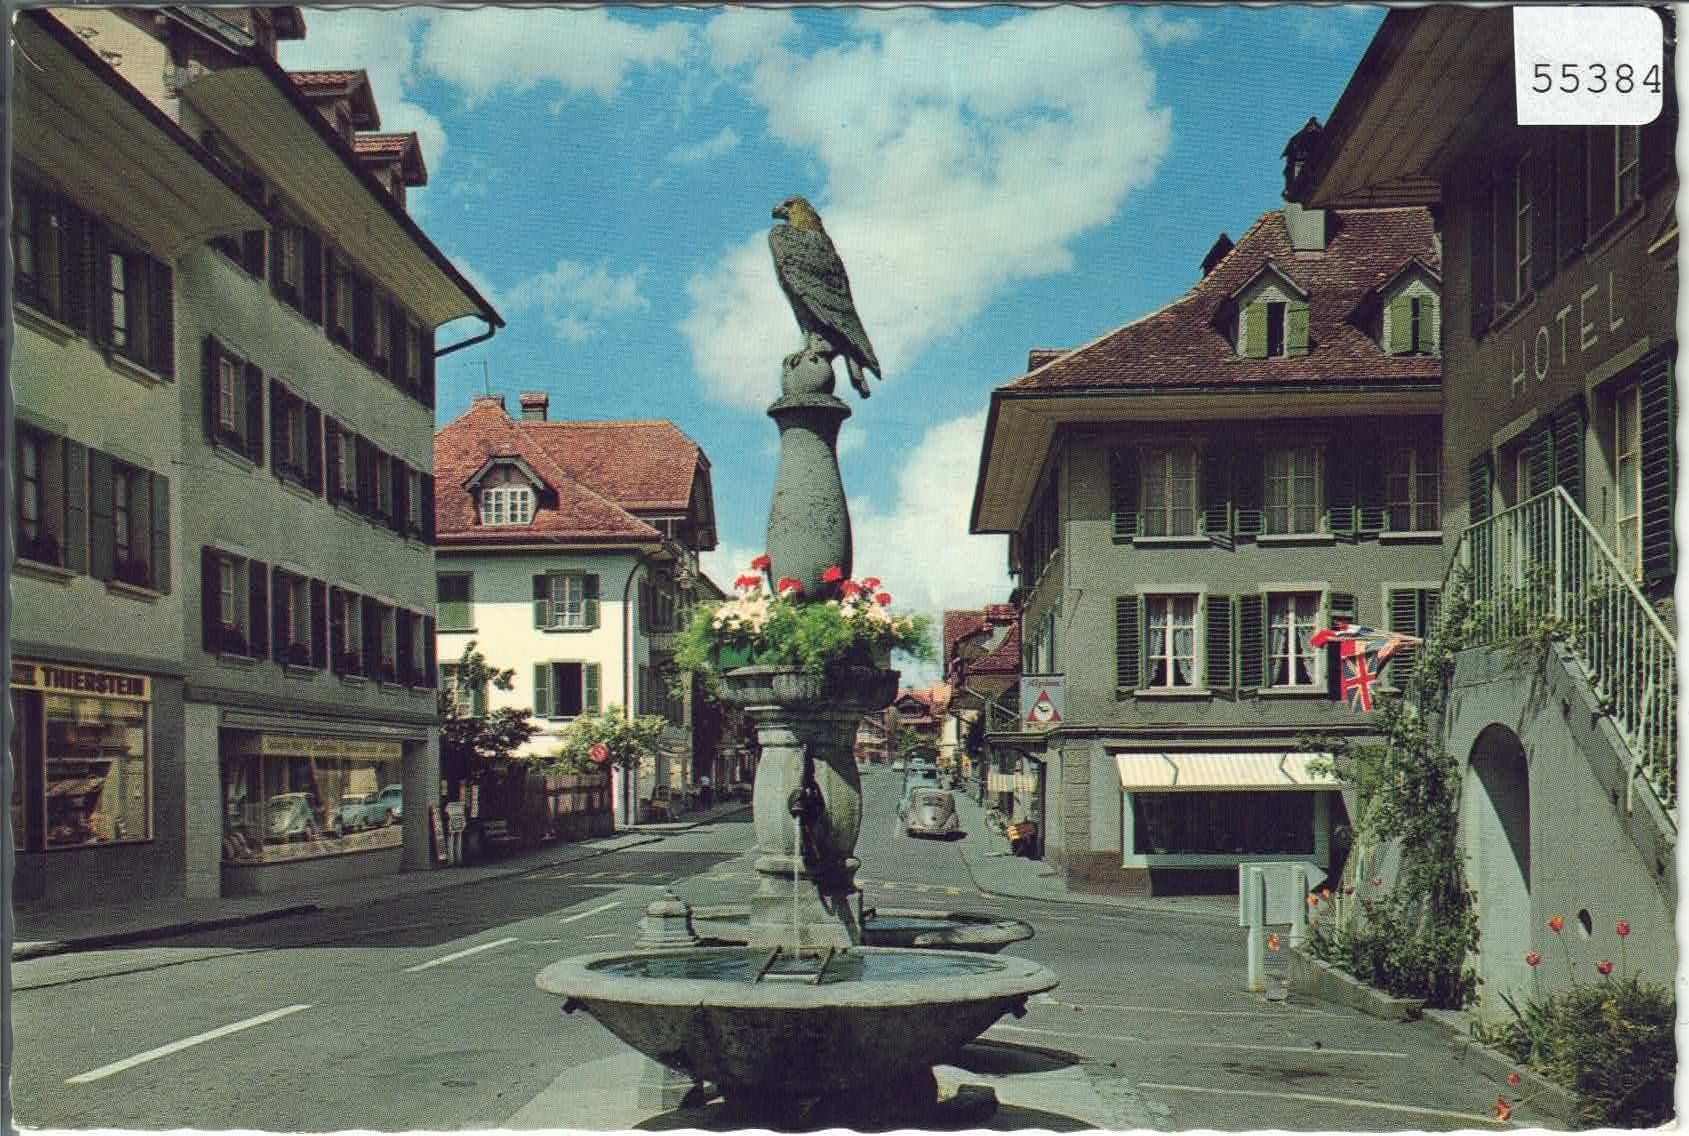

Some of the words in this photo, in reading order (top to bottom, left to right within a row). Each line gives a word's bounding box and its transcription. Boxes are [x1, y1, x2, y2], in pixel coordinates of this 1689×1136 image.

[1531, 63, 1661, 93] 55384
[1511, 271, 1625, 399] HOTEL
[41, 668, 145, 696] THIERSTEIN
